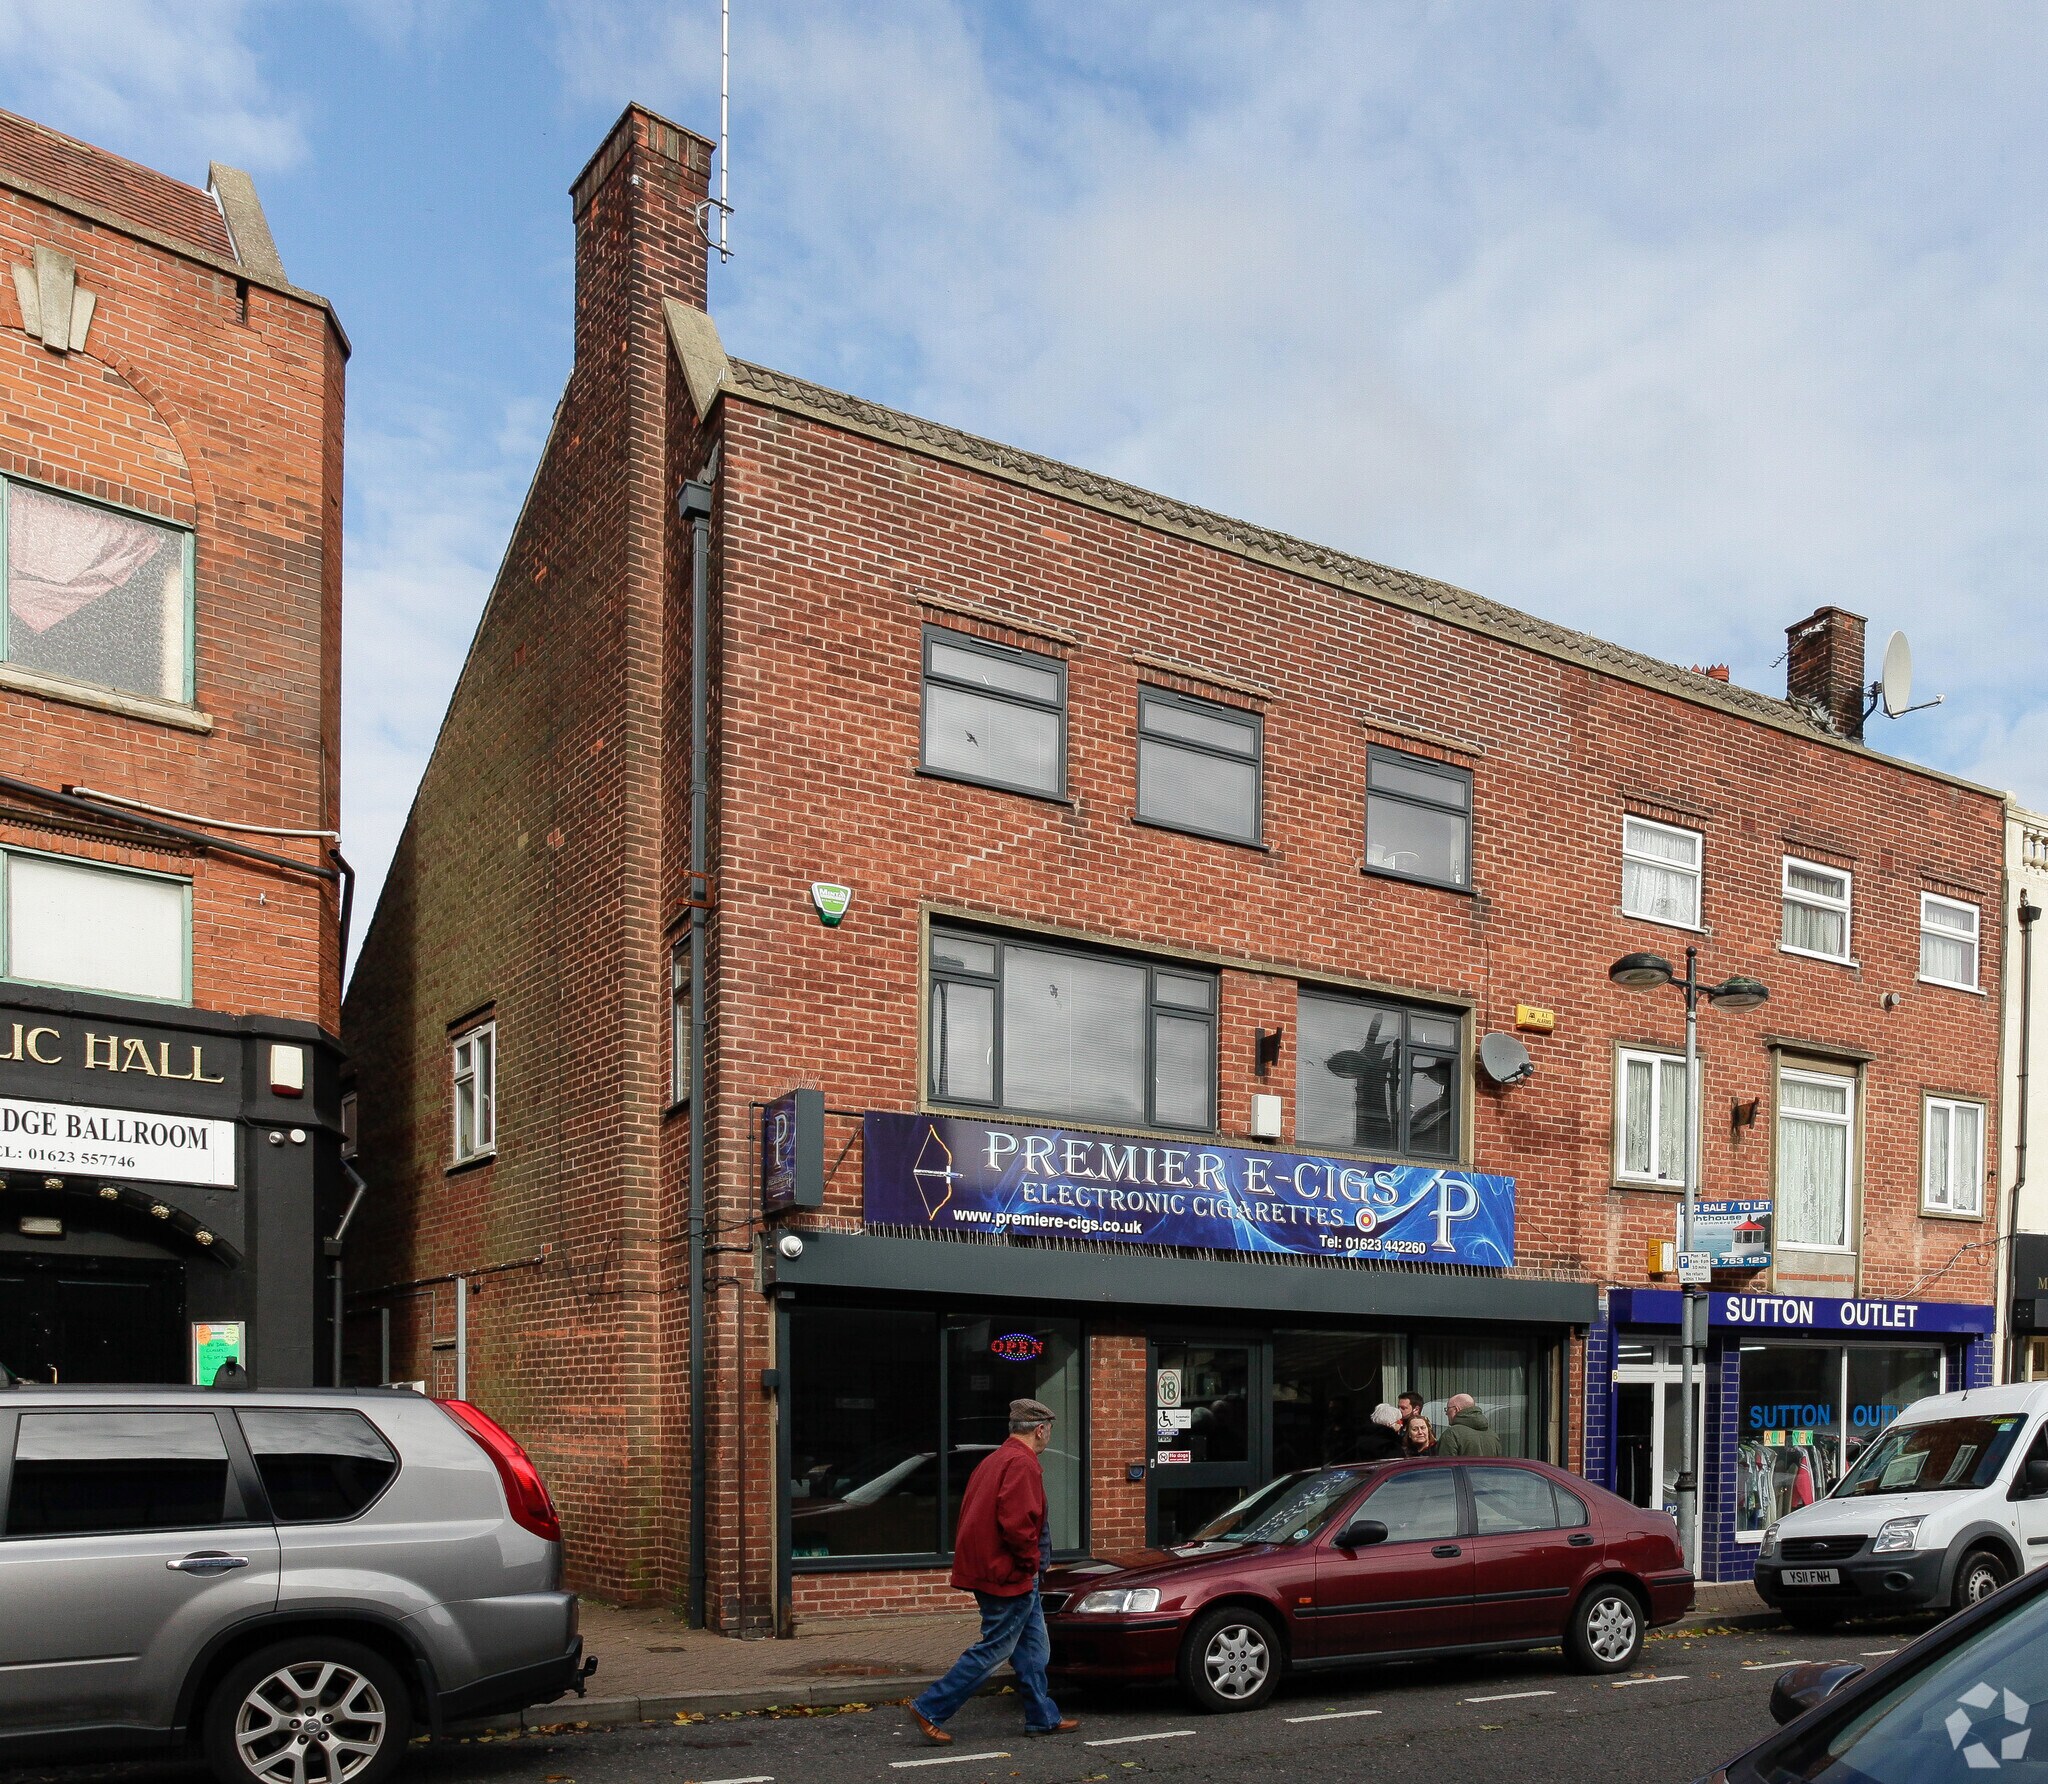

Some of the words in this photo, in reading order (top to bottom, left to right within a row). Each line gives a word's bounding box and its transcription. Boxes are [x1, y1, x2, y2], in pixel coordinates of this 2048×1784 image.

[85, 1032, 224, 1084] HALL
[0, 1107, 57, 1136] DGE
[66, 1114, 208, 1150] BALLROOM
[773, 1113, 787, 1168] P
[28, 1148, 75, 1163] 01623
[81, 1152, 135, 1168] 557746
[981, 1130, 1229, 1192] PREMIER
[1244, 1157, 1399, 1205] E-CIGS
[1022, 1181, 1186, 1215] ELECTRONIC
[1193, 1196, 1344, 1227] CIGARETTES
[1428, 1178, 1480, 1253] P
[1703, 1203, 1727, 1212] SALE
[1738, 1202, 1751, 1211] TO
[1753, 1202, 1770, 1210] LET
[953, 1210, 1142, 1234] www.premiere-cigs.co.uk
[1319, 1235, 1342, 1249] Tel:
[1345, 1237, 1382, 1251] 01623
[1384, 1240, 1426, 1254] 442260
[1746, 1256, 1767, 1264] 123
[1726, 1297, 1813, 1324] SUTTON
[1840, 1302, 1918, 1327] OUTLET
[991, 1340, 1044, 1354] OPEN
[1161, 1381, 1176, 1400] 18
[1750, 1404, 1830, 1428] SUTTON
[1764, 1432, 1784, 1445] ALL
[1793, 1432, 1812, 1446] NEW
[1810, 1571, 1831, 1583] FNH
